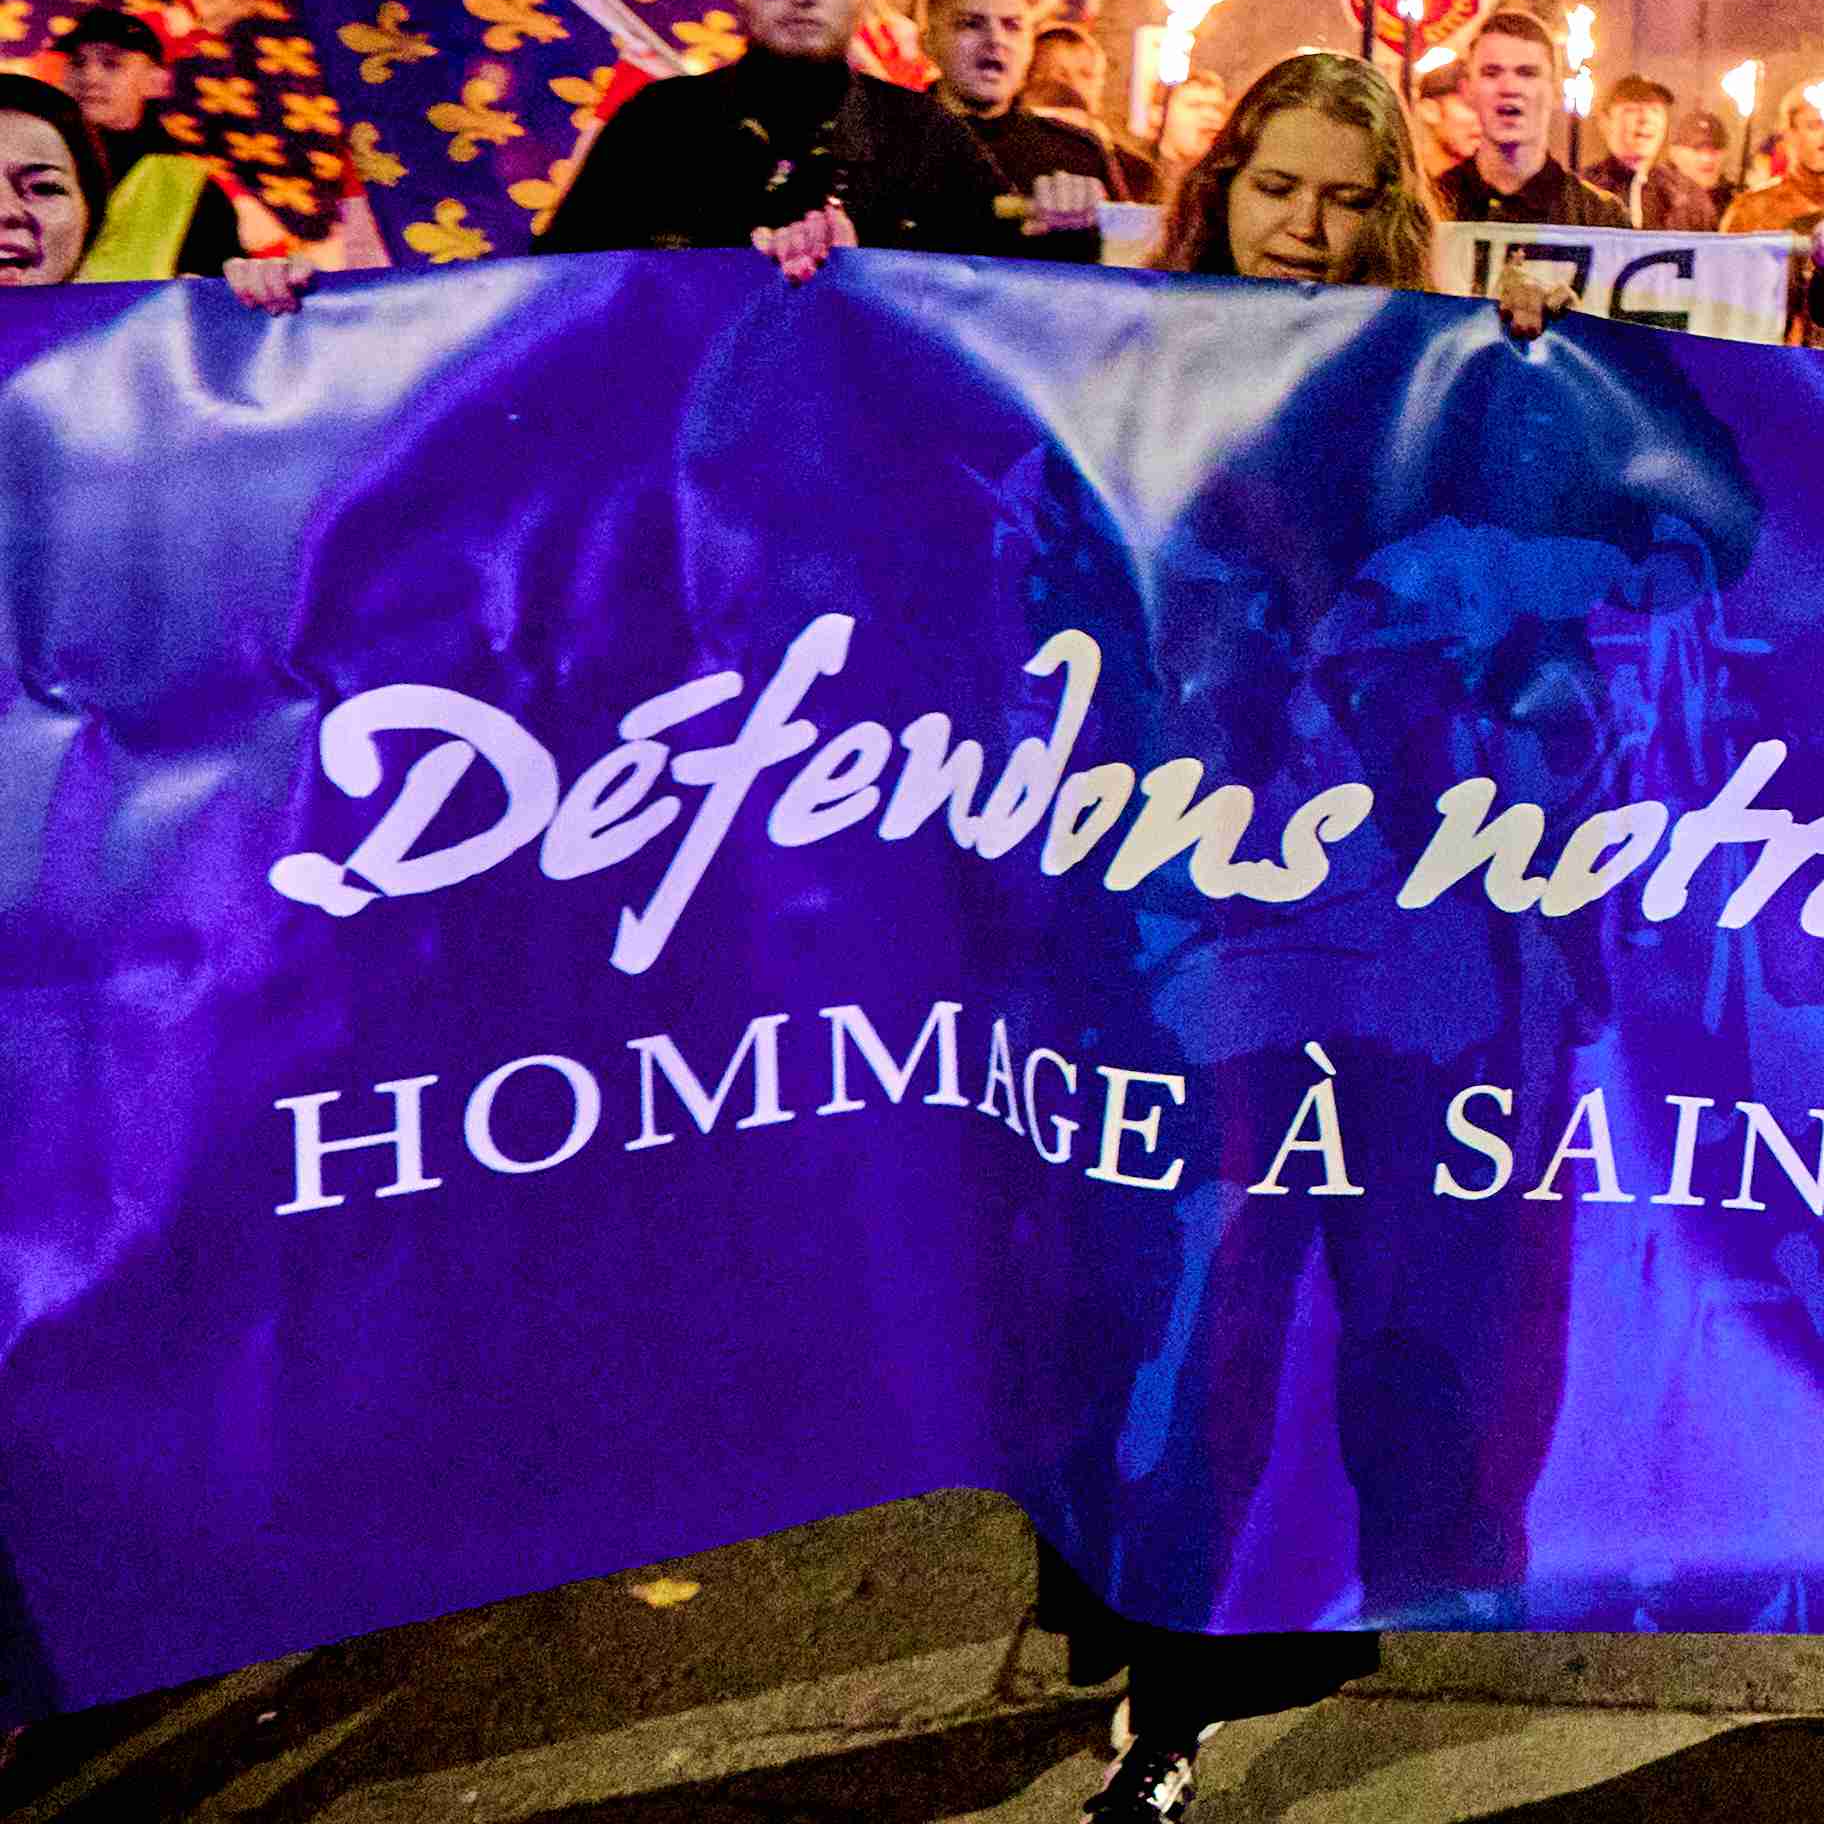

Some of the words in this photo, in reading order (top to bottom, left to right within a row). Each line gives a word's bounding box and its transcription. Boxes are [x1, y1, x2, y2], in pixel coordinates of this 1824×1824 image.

[267, 612, 1374, 976] Défendons
[273, 999, 1189, 1217] HOMMAGE
[1246, 1040, 1366, 1197] À
